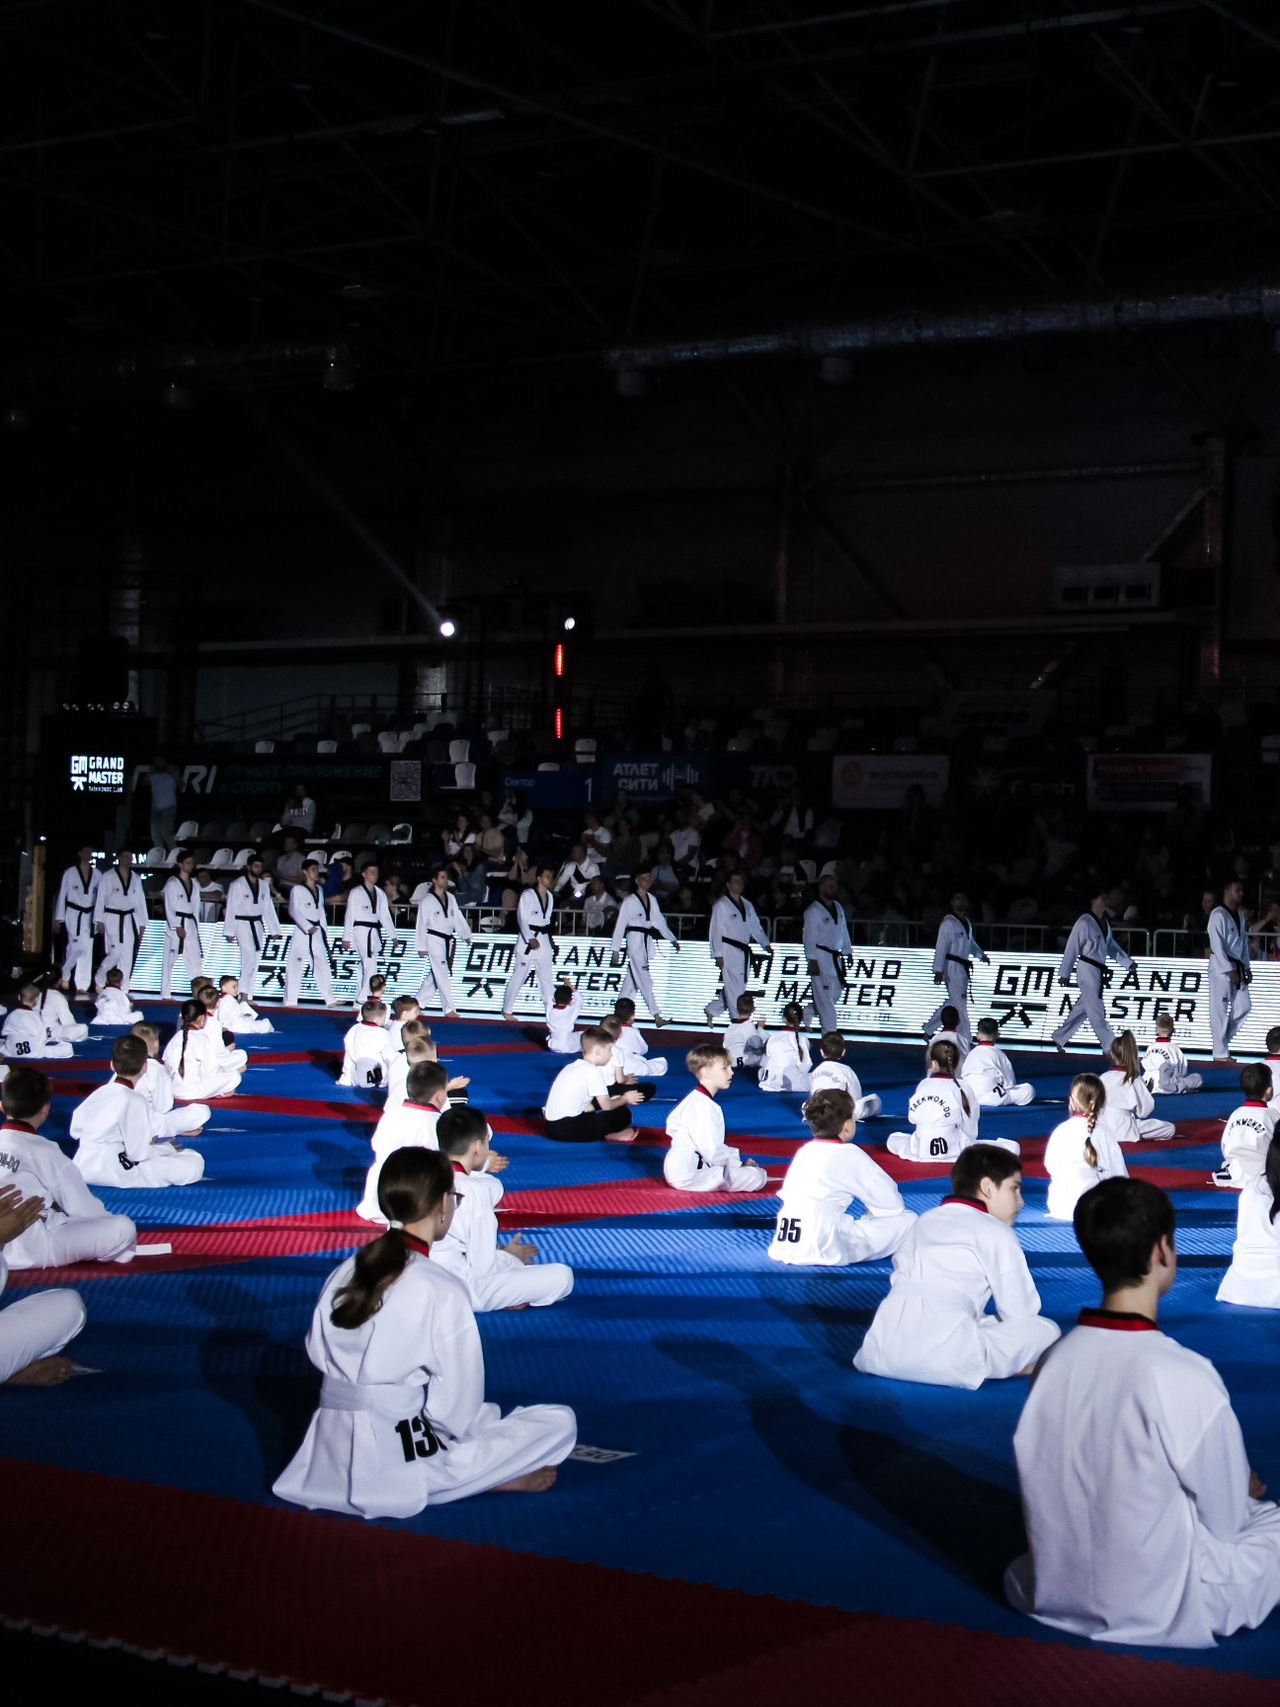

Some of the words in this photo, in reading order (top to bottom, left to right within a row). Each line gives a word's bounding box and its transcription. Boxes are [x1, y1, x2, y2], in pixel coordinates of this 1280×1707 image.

[88, 756, 125, 771] GRAND
[612, 763, 659, 777] АТЛЕТ
[88, 770, 125, 785] MASTER
[618, 778, 658, 792] СИТИ
[584, 777, 593, 803] 1
[466, 942, 515, 972] GM
[994, 965, 1056, 997] GM
[775, 980, 895, 1007] MATER
[1059, 993, 1196, 1022] MSTER
[15, 1040, 31, 1056] 38
[929, 1137, 949, 1156] 60
